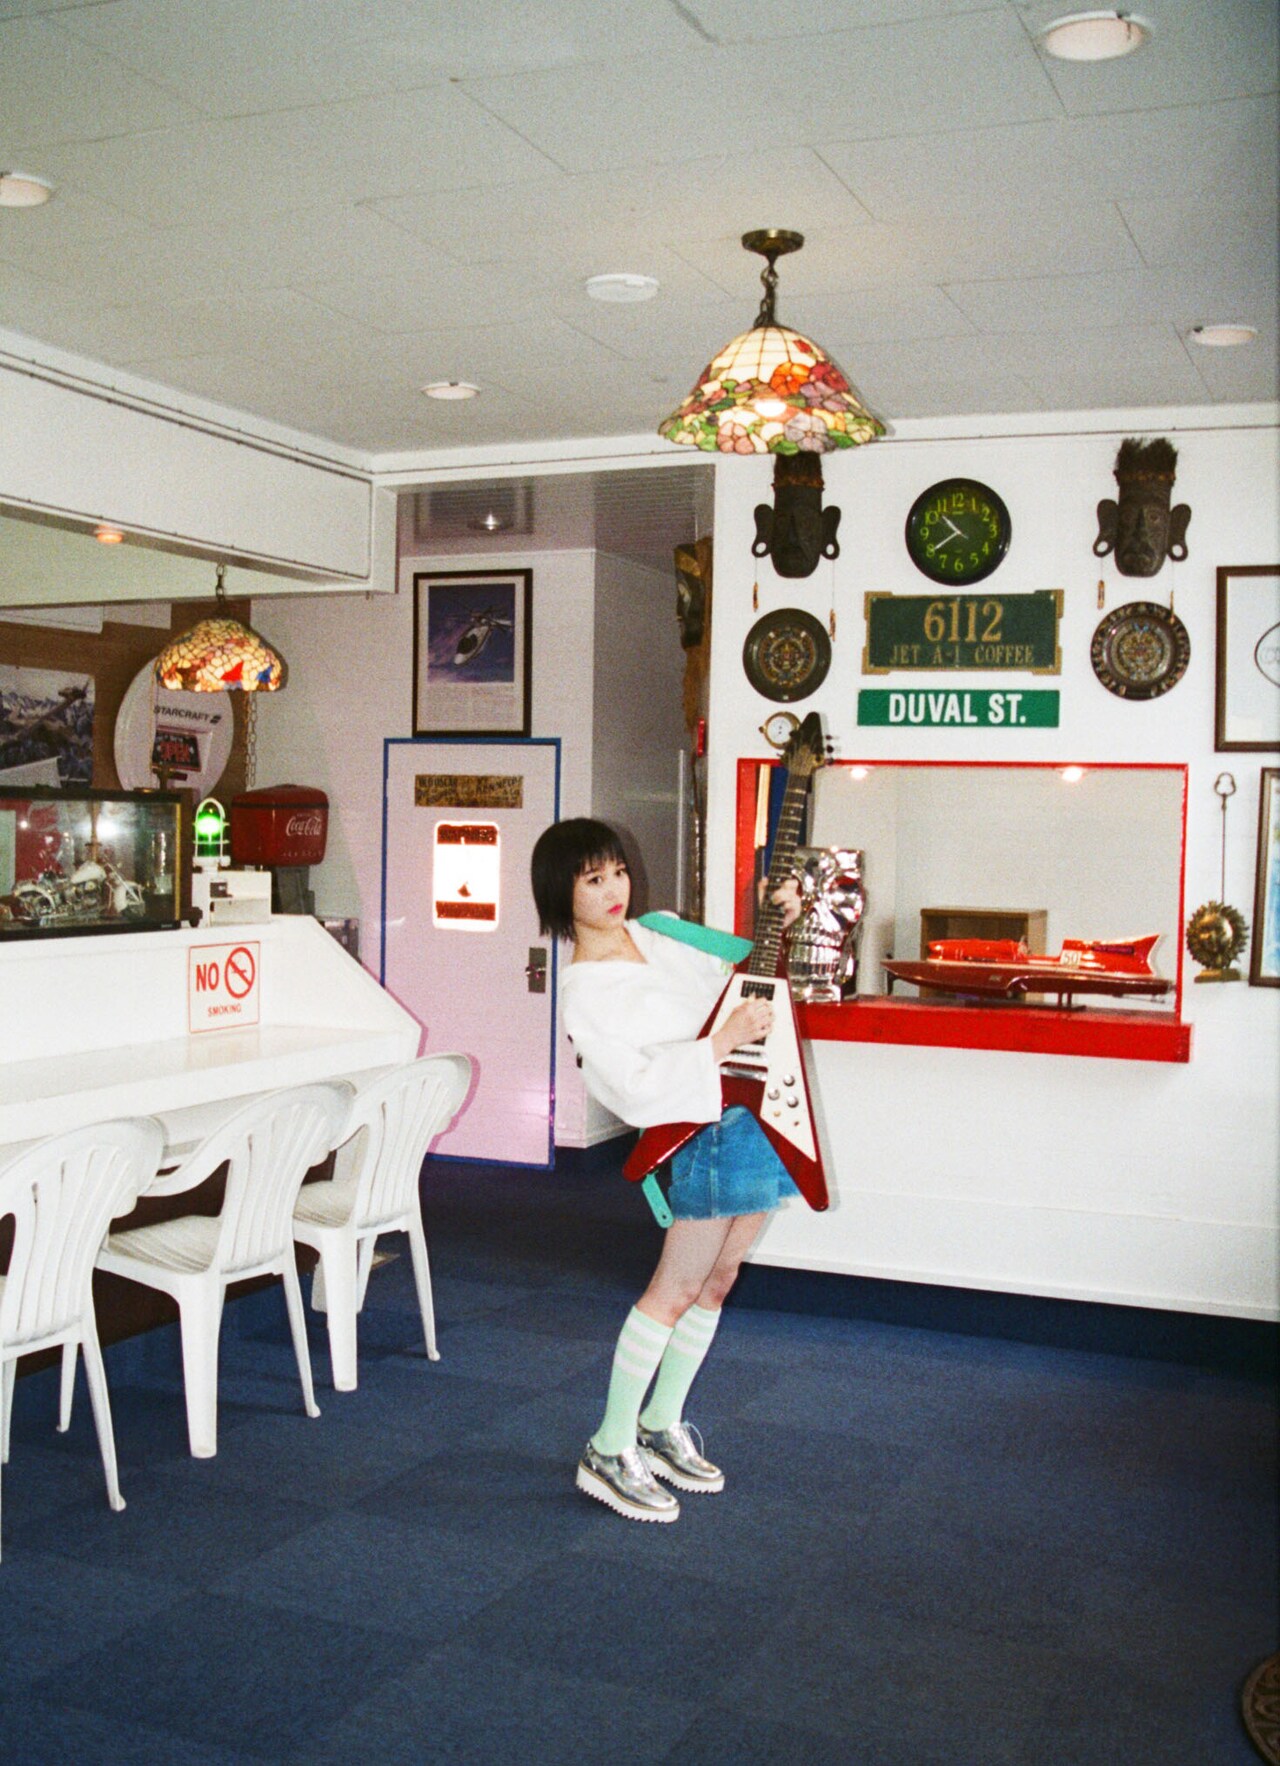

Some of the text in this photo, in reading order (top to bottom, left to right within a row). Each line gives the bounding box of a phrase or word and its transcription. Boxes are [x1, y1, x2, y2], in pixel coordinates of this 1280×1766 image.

[937, 499, 947, 512] 11
[952, 492, 964, 507] 12
[925, 510, 939, 525] 10
[982, 506, 990, 521] 2
[920, 527, 929, 540] 9
[989, 524, 998, 538] 3
[926, 543, 936, 558] 8
[982, 541, 989, 555] 4
[940, 554, 947, 569] 7
[954, 558, 964, 572] 6
[970, 552, 979, 566] 5
[923, 601, 1004, 643] 6112
[890, 644, 920, 663] JET
[974, 644, 1035, 664] COFFEE
[153, 704, 210, 721] STARCRAFT
[889, 692, 1027, 724] DUVAL ST.
[196, 962, 220, 992] NO
[208, 1003, 242, 1018] SMOKING
